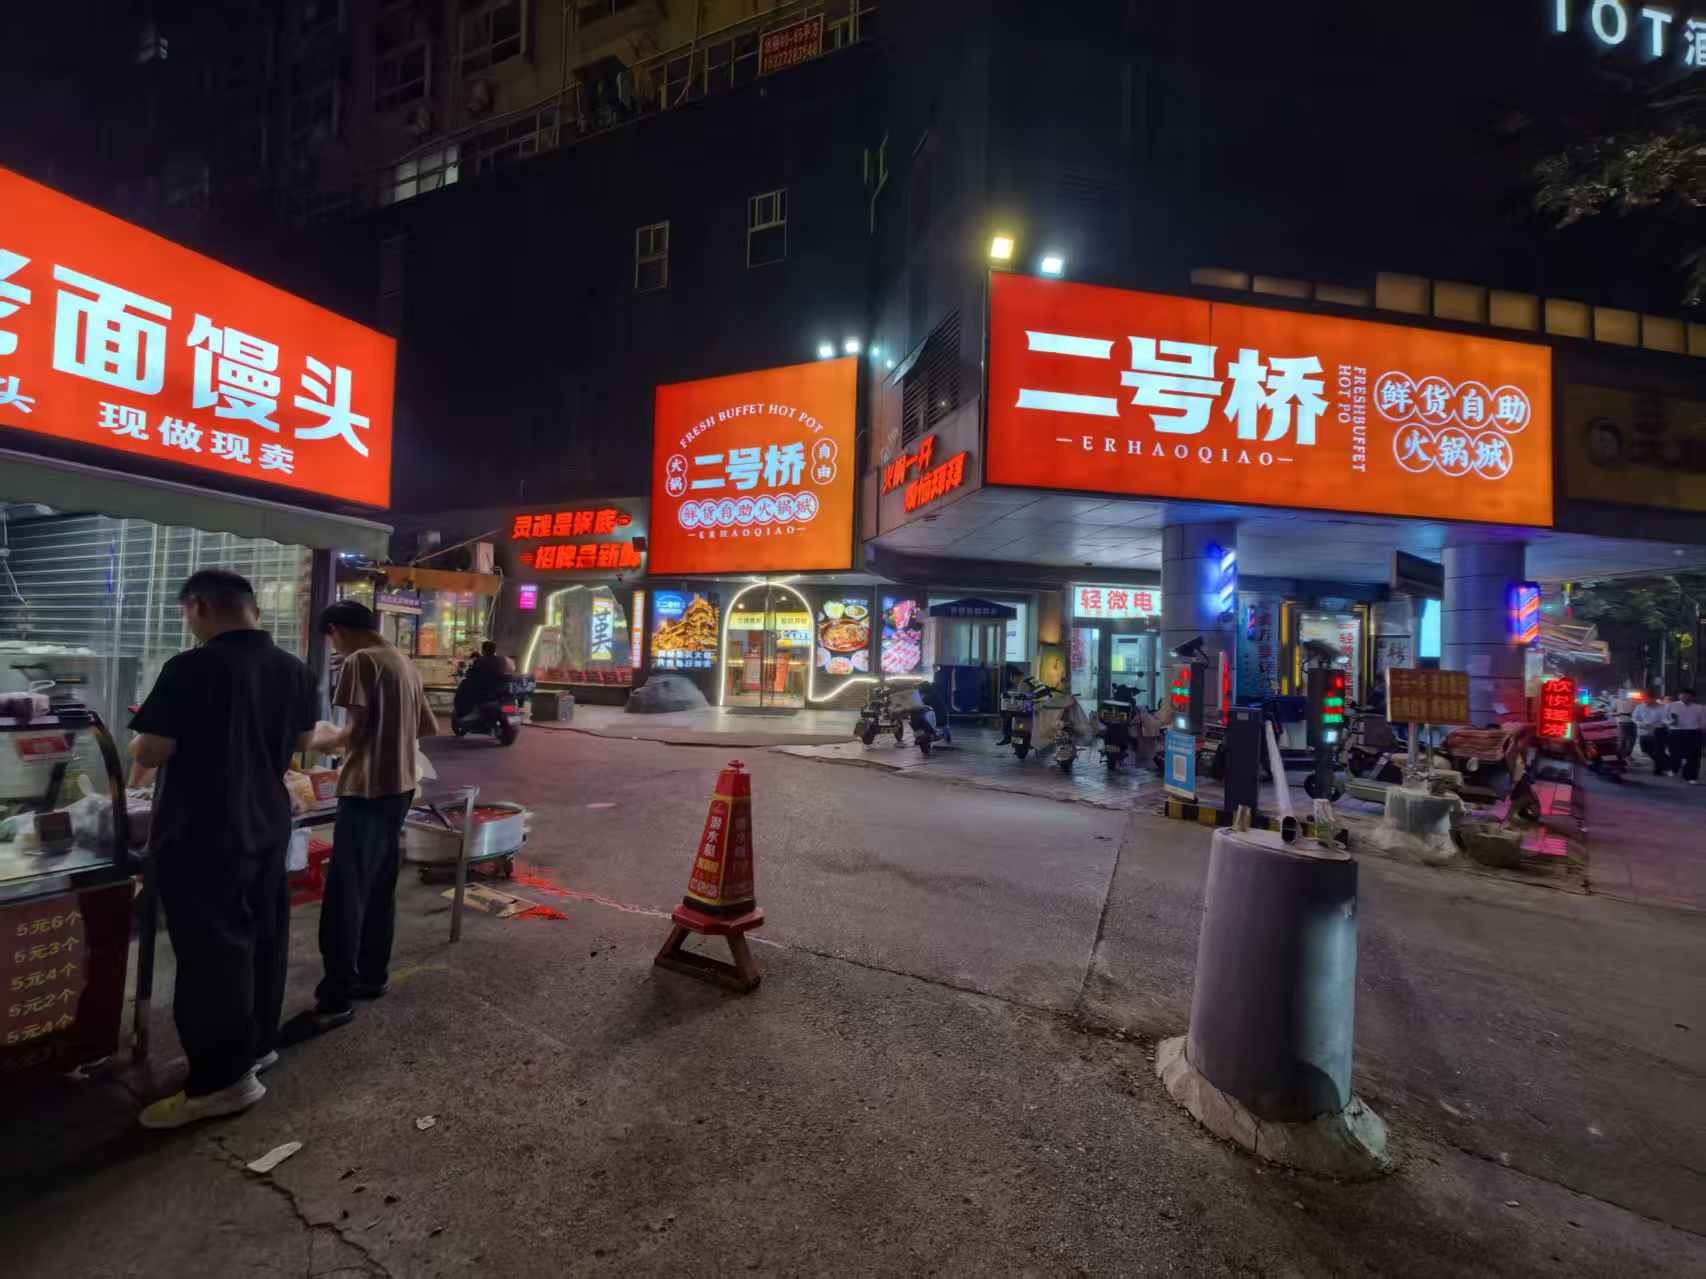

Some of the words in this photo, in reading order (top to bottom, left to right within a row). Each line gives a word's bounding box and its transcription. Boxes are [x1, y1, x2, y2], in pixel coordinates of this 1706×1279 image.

[1015, 330, 1329, 446] 二号桥
[1381, 380, 1528, 425] 鲜货自助
[98, 401, 295, 475] 现做现卖
[680, 417, 716, 449] FRESH
[718, 403, 765, 421] BUFFET
[768, 403, 797, 418] HOT
[799, 411, 824, 434] POT
[690, 441, 806, 490] 二号桥
[1401, 430, 1507, 472] 火锅城
[1081, 588, 1153, 612] 轻微电
